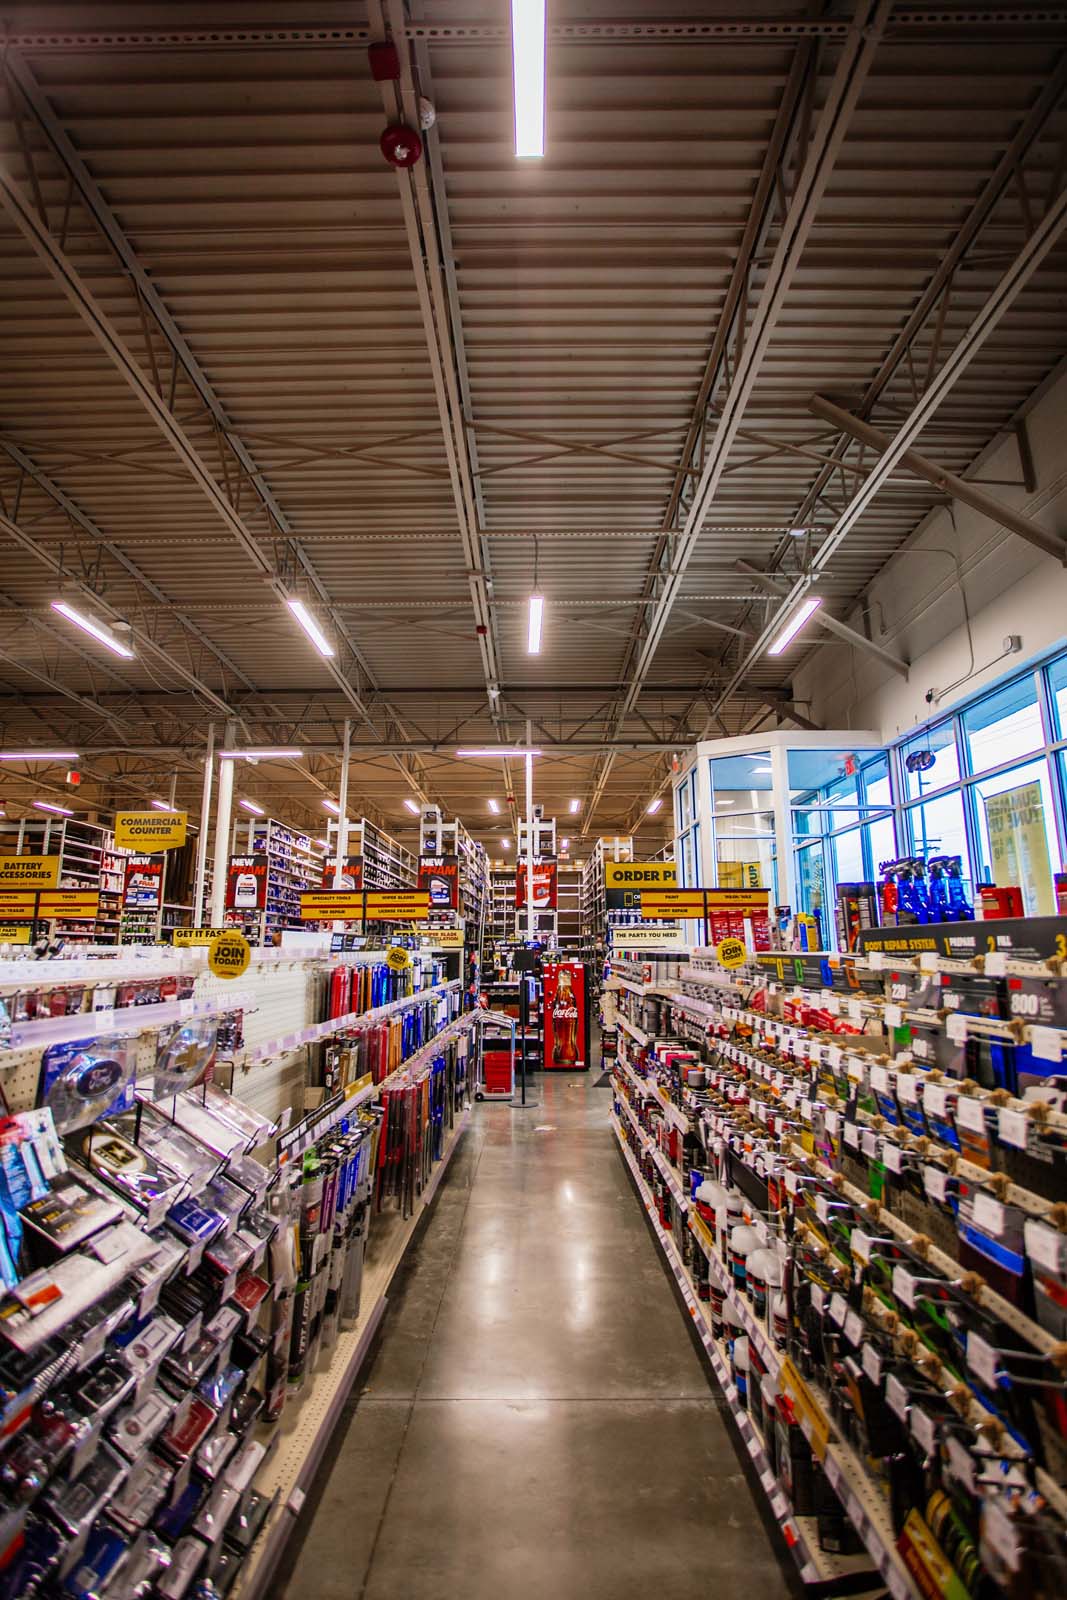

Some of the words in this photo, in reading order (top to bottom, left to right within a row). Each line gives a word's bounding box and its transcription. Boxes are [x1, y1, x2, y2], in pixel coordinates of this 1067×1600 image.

[121, 818, 182, 826] COMMERCIAL
[129, 827, 172, 835] COUNTER
[128, 857, 151, 865] NEW
[326, 858, 349, 866] NW
[421, 858, 444, 866] NEW
[519, 857, 543, 865] NW
[127, 864, 162, 874] FRAM
[229, 866, 266, 875] FRAM
[420, 866, 457, 875] FRAM
[0, 871, 52, 879] CCESSORIES
[612, 870, 659, 881] ORDER
[1055, 933, 1067, 958] 3
[214, 946, 245, 959] JOIN
[722, 945, 742, 957] JOIN
[722, 951, 744, 961] TODAY!
[214, 957, 244, 966] TODAY!
